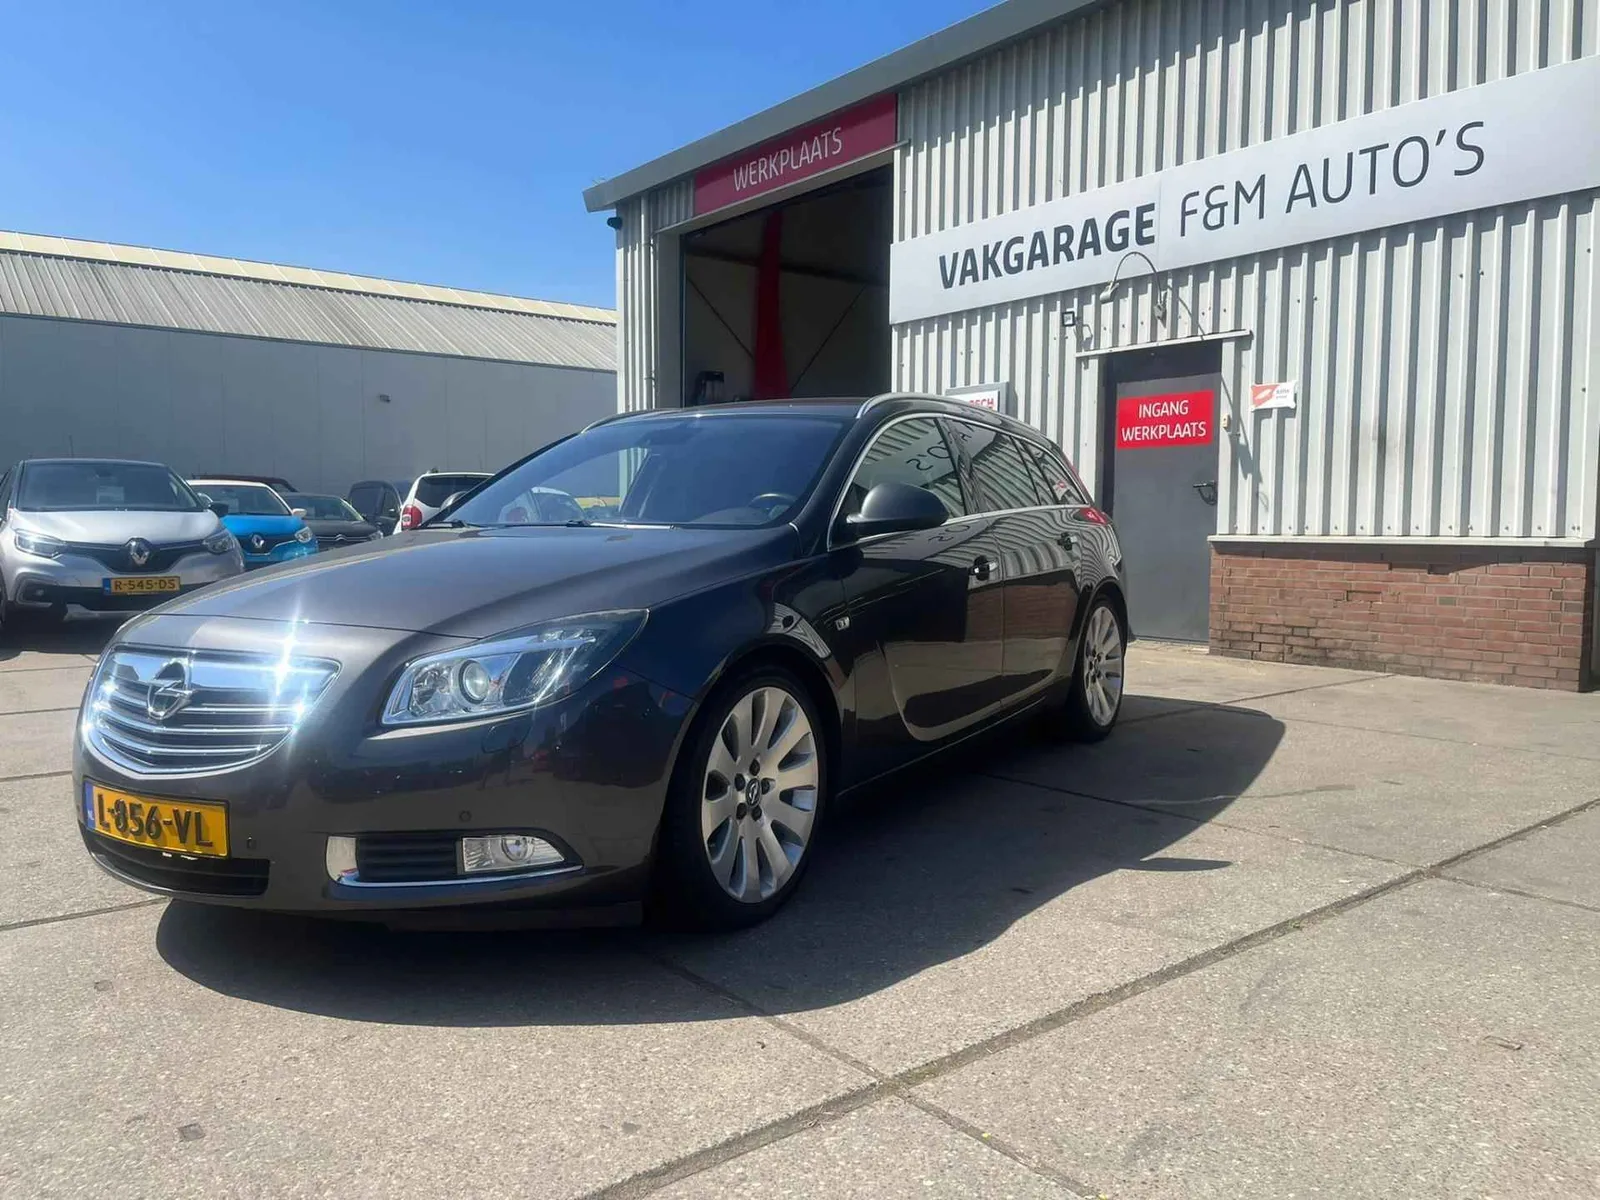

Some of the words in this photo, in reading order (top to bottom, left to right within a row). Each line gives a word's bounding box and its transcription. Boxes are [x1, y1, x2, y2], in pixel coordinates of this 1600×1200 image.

[733, 127, 843, 192] WERKPLAATS
[939, 202, 1156, 290] VAKGARAGE
[1180, 173, 1266, 237] F&M
[1285, 121, 1485, 214] AUTO'S
[1138, 400, 1189, 419] INGANG
[1121, 421, 1207, 442] WERKPLAATS
[114, 579, 176, 591] R-545-DS
